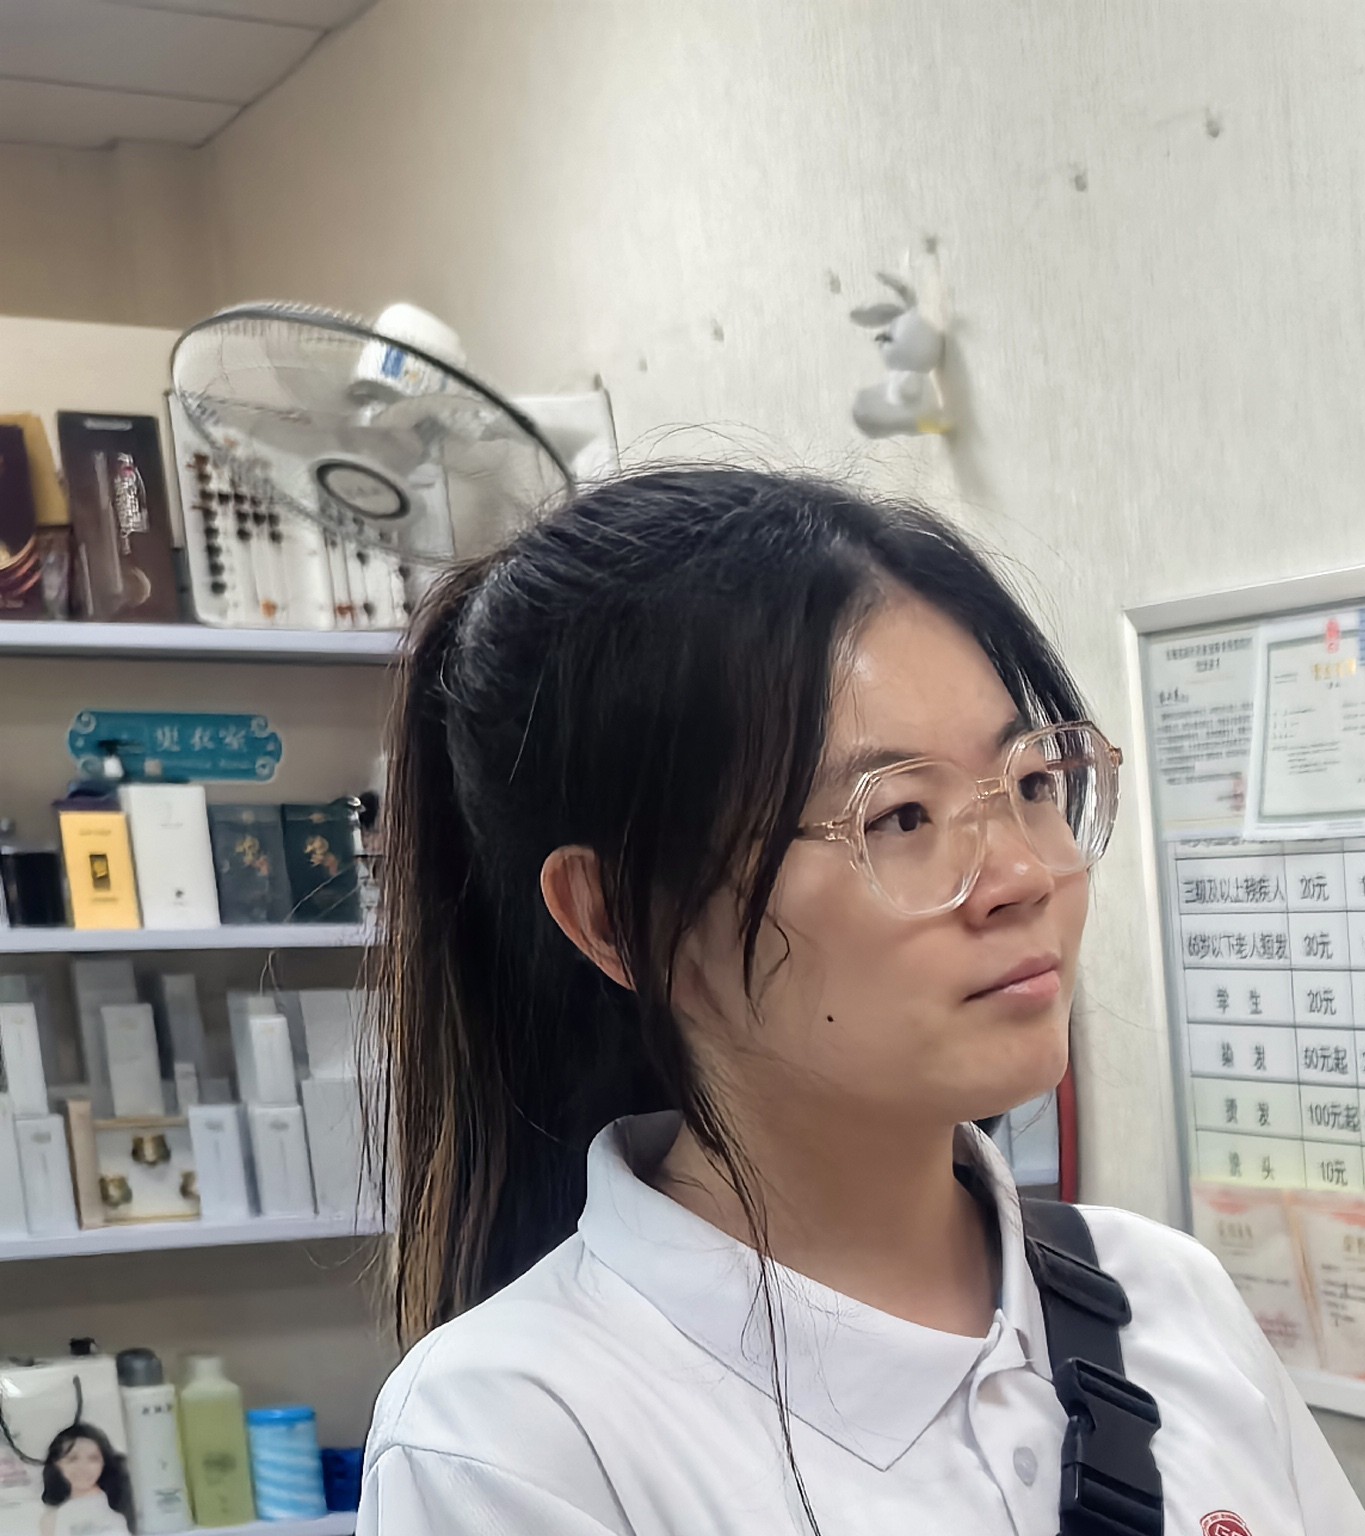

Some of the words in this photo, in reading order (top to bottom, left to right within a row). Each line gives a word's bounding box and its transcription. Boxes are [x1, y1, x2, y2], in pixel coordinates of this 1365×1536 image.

[1299, 874, 1330, 902] 20元
[1306, 988, 1337, 1017] 20元
[1303, 1045, 1349, 1076] 50元起
[1307, 1101, 1361, 1133] 100元起
[1319, 1159, 1349, 1188] 10元
